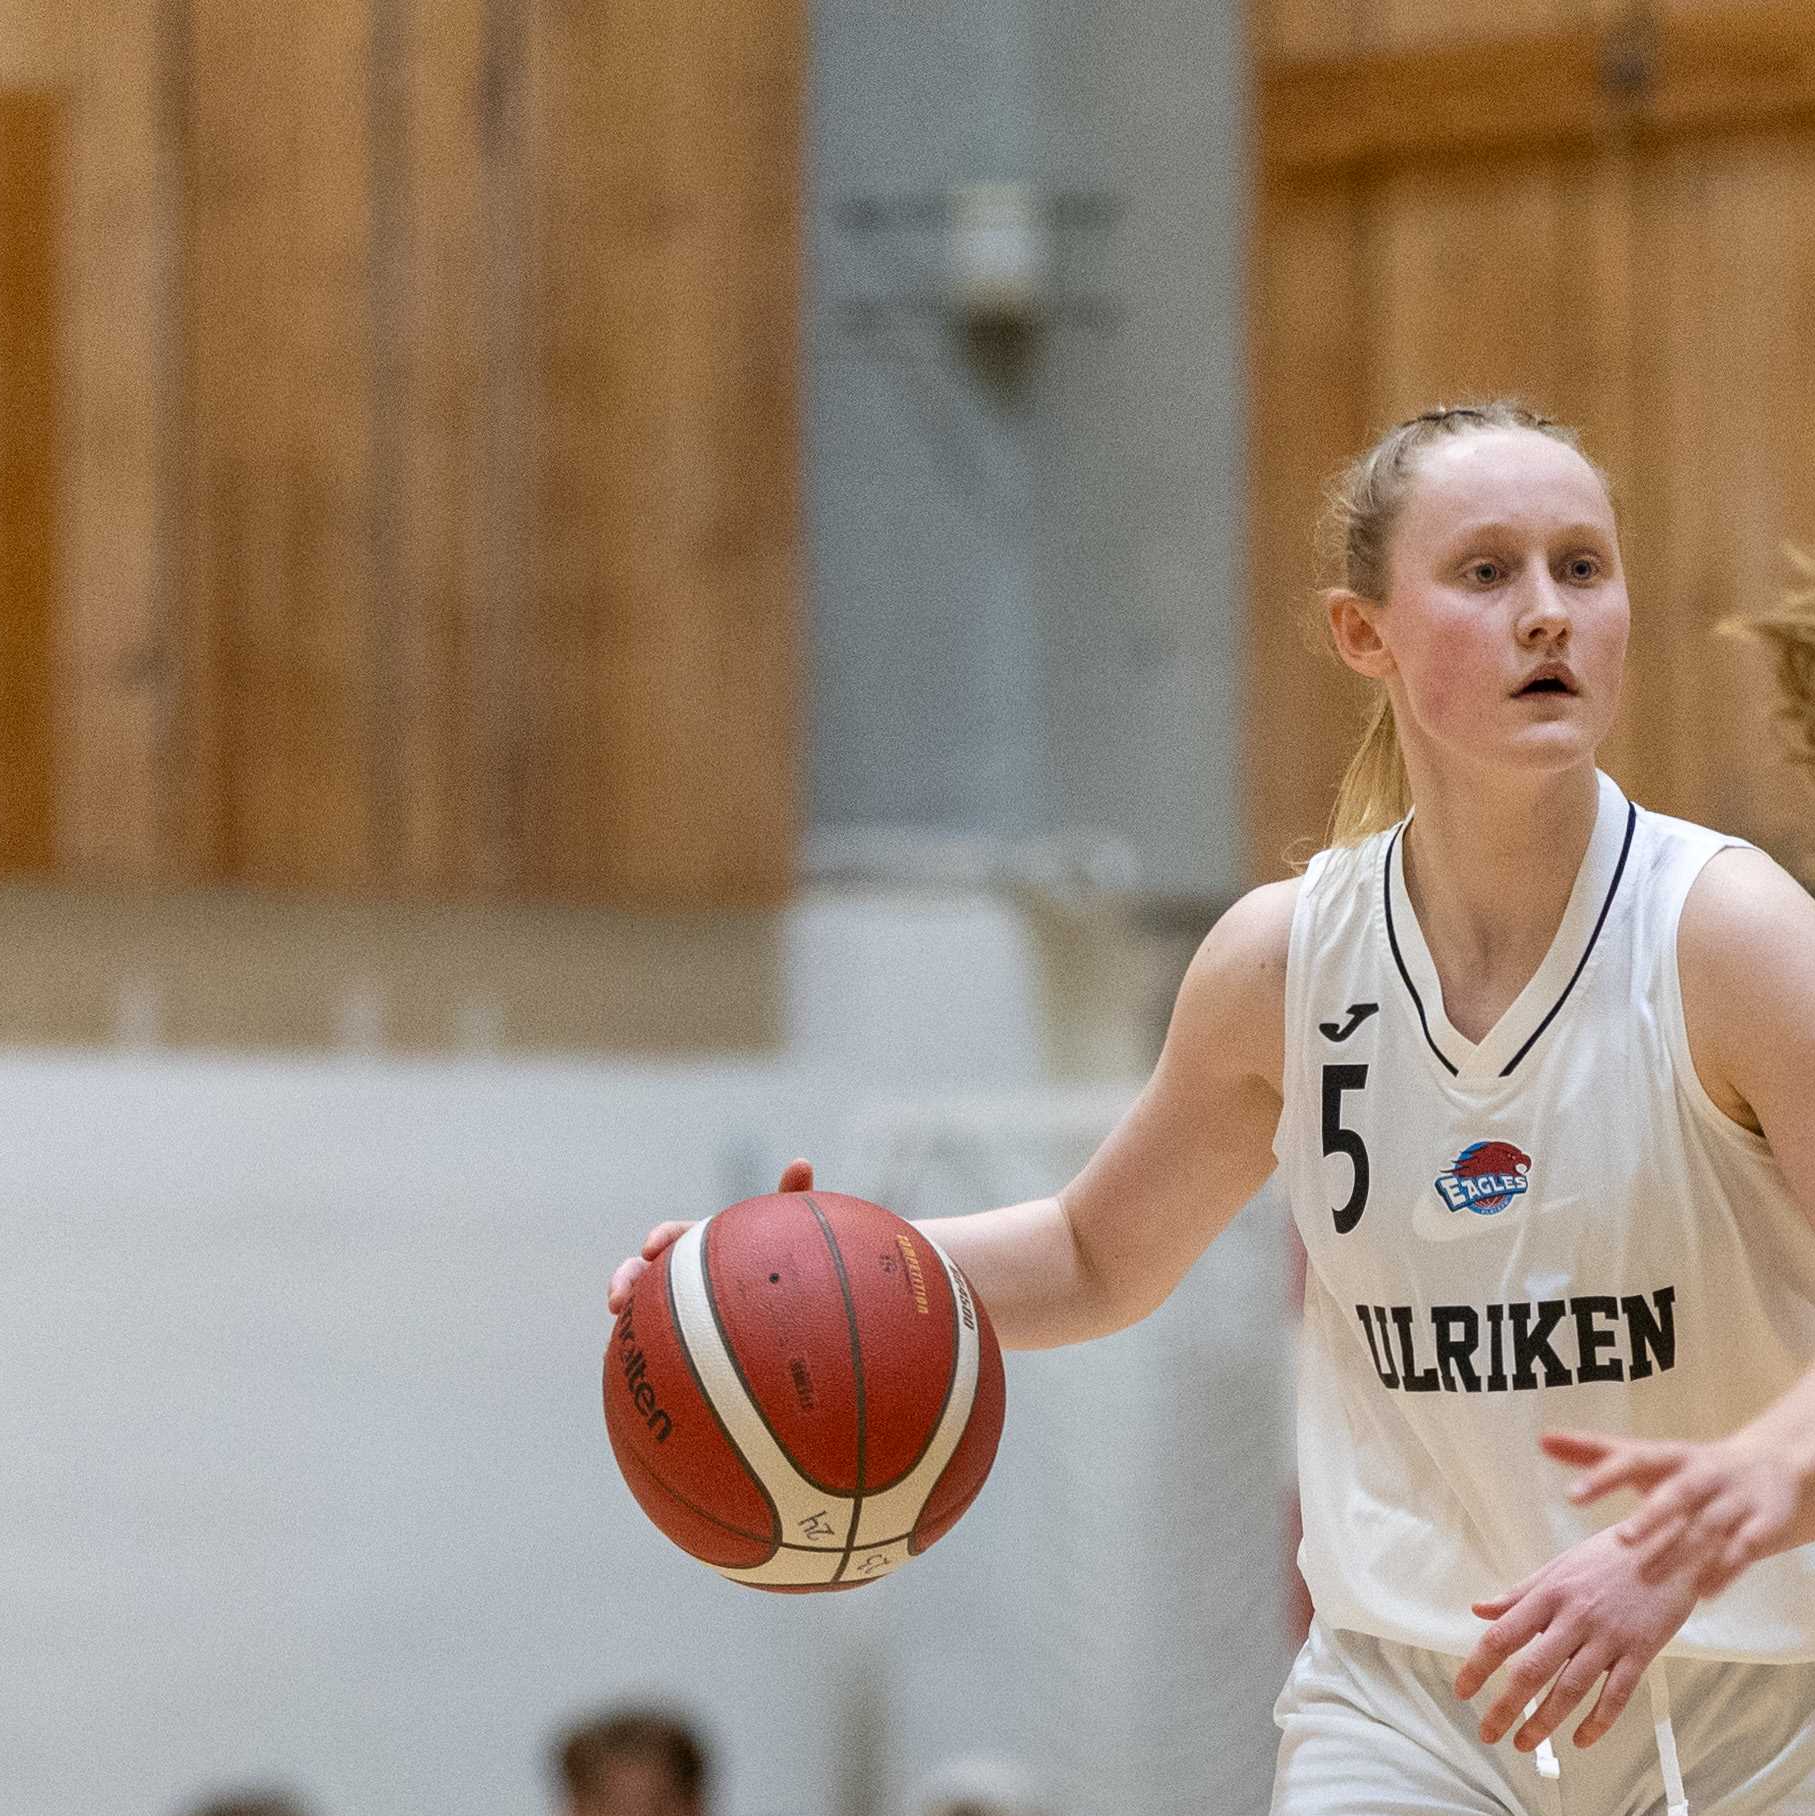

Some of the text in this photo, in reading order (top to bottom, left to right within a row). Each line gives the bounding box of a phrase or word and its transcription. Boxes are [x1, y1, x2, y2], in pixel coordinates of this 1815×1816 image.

[1320, 1063, 1371, 1235] 5
[1439, 1175, 1527, 1207] EAGLES
[1356, 1286, 1676, 1393] ULRIKEN
